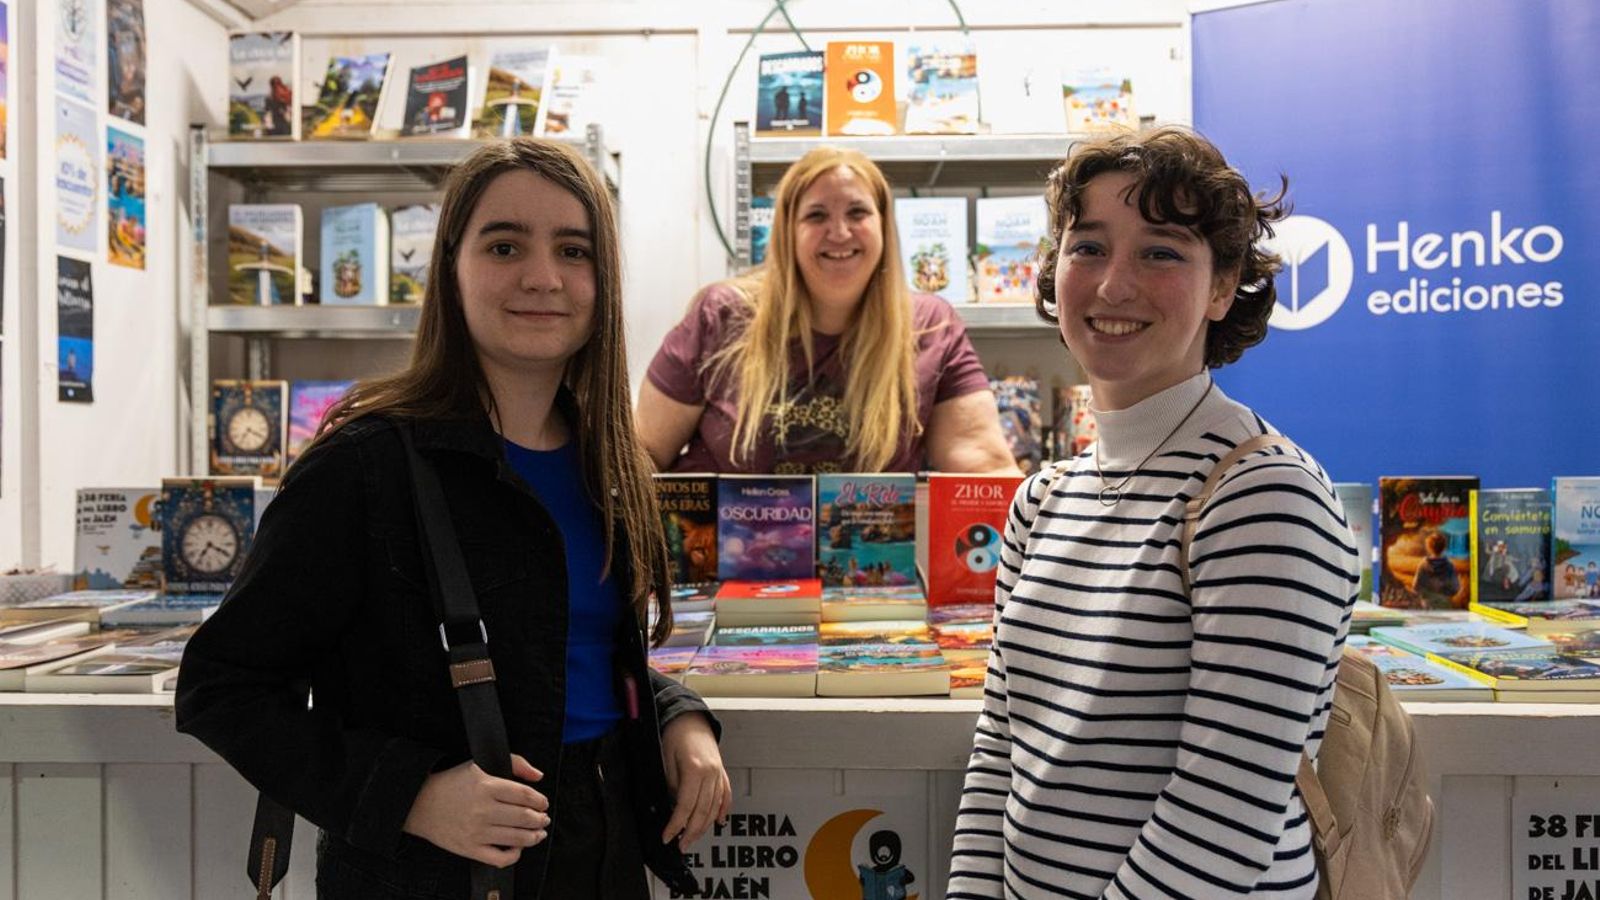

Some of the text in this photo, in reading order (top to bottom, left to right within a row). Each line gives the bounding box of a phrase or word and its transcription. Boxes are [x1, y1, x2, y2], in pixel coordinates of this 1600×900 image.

[1366, 210, 1564, 273] Henko
[1366, 277, 1564, 315] ediciones
[691, 482, 710, 493] DE
[954, 484, 1004, 499] ZHOR
[98, 493, 127, 502] FERIA
[97, 504, 127, 513] LIBRO
[720, 507, 812, 521] OSCURIDAD
[1484, 526, 1499, 536] en
[718, 625, 815, 635] DESCARRIADOS
[1528, 814, 1568, 838] 38
[683, 845, 799, 869] EL LIBRO
[1528, 854, 1566, 871] DEL
[701, 872, 770, 899] JAÉN
[1528, 887, 1555, 900] DE
